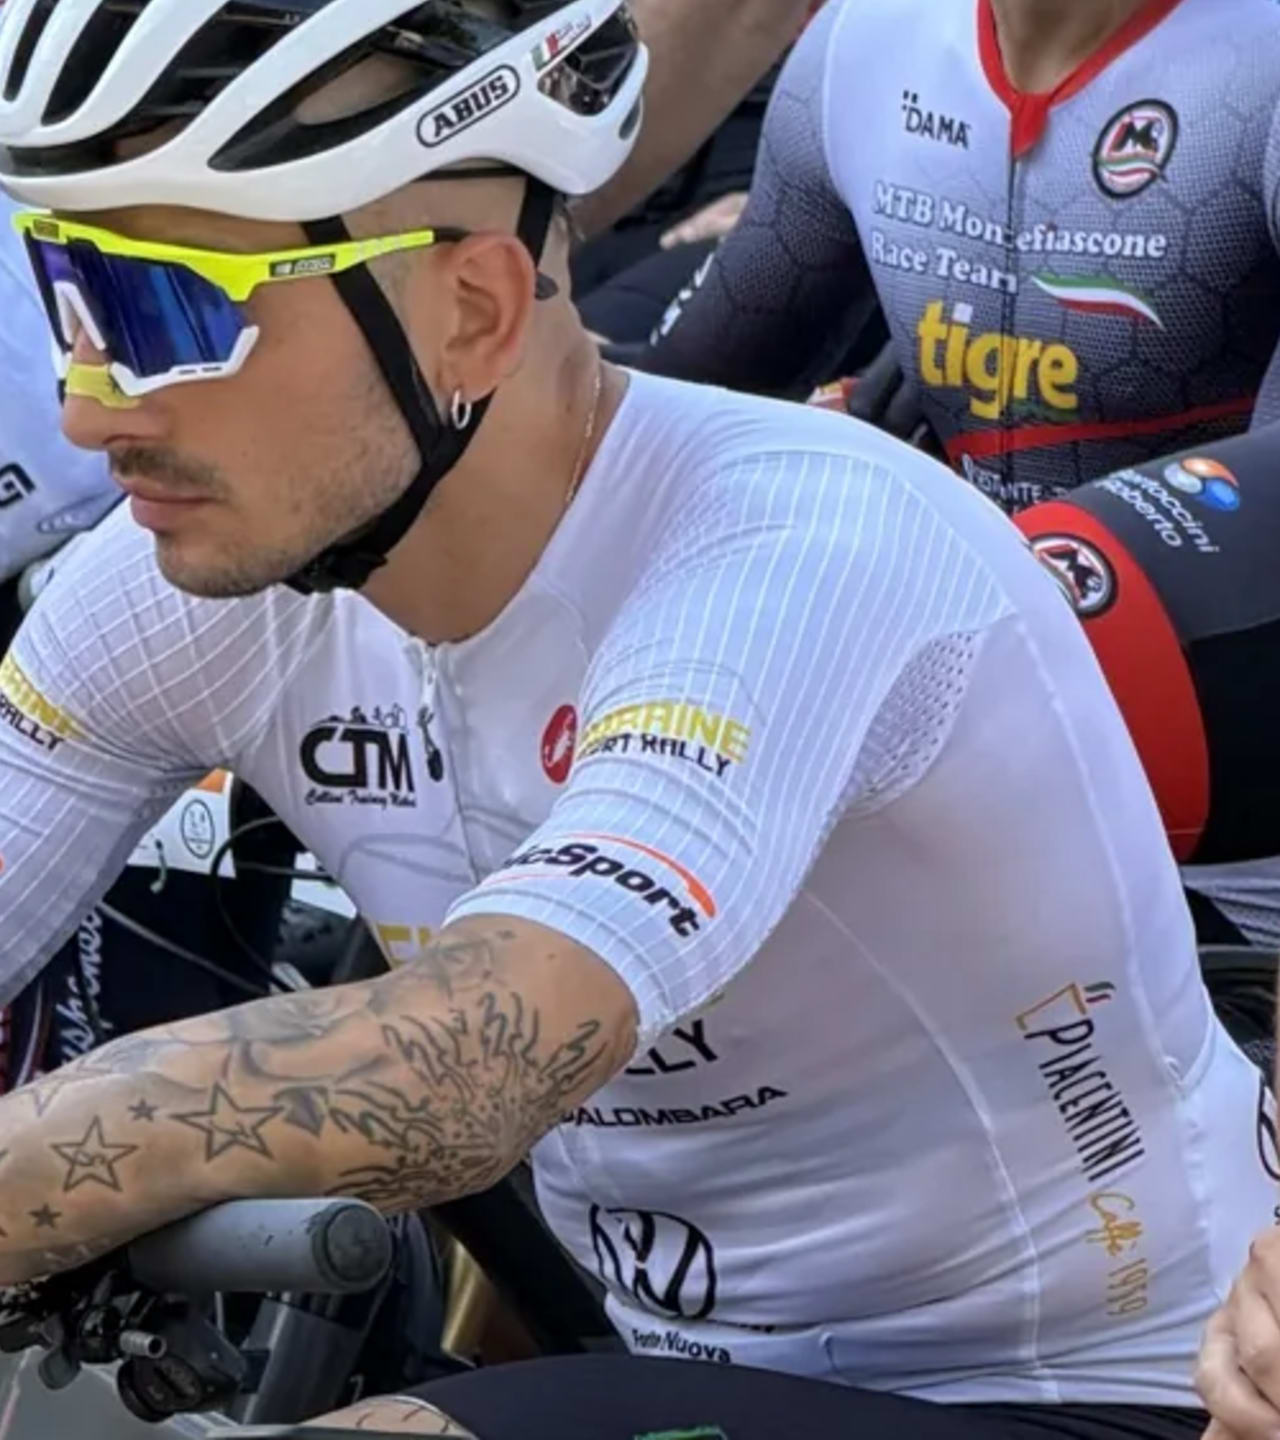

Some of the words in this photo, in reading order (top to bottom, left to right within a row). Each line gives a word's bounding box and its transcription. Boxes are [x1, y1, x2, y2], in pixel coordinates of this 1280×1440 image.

[432, 75, 512, 139] ABUS
[904, 103, 972, 149] DAMA
[872, 181, 934, 225] MTB
[871, 231, 928, 277] Race
[935, 247, 1019, 295] Team
[918, 299, 1080, 420] tigre
[641, 732, 732, 778] RALLY
[1023, 1019, 1146, 1183] PIACENTINI
